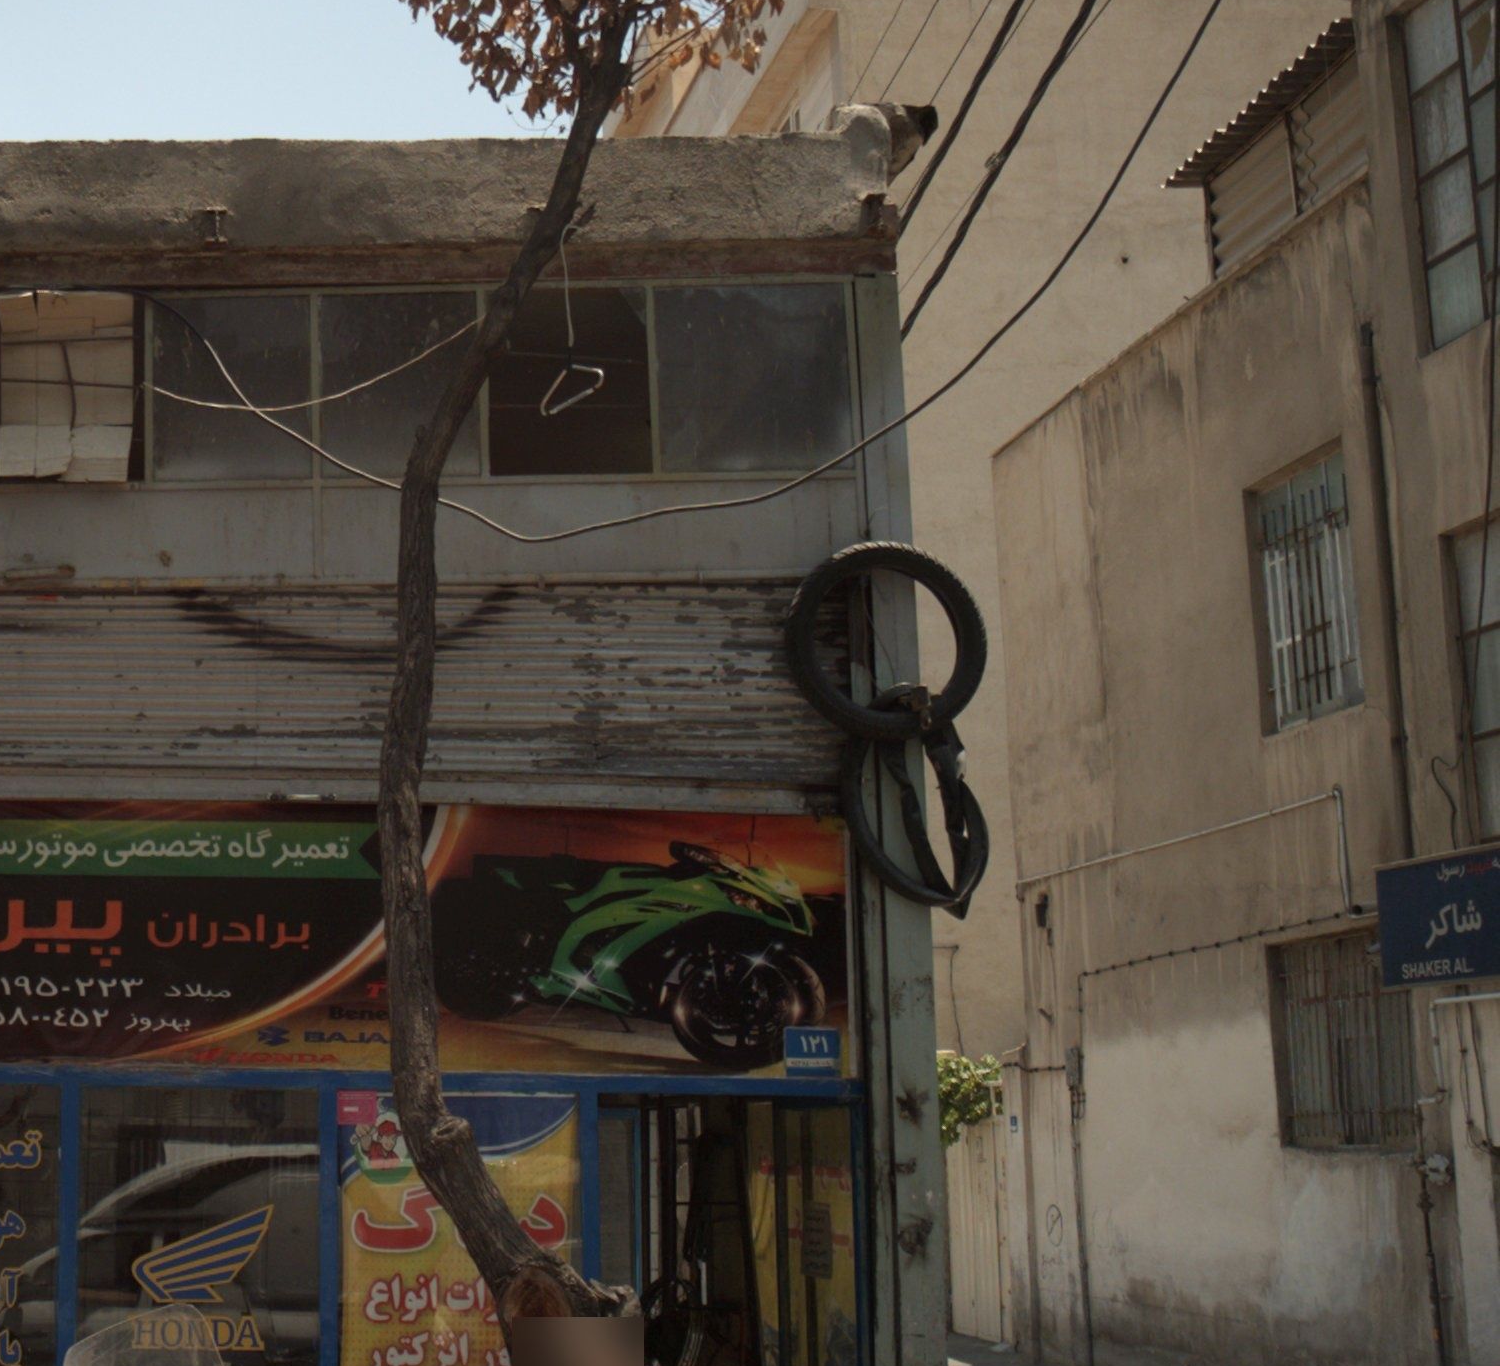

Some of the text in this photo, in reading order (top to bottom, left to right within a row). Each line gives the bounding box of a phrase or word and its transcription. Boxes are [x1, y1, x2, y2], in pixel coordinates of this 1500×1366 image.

[103, 832, 222, 867] تخصصی
[1437, 863, 1466, 882] رسول
[146, 911, 312, 951] برادران
[1424, 899, 1482, 950] شاکر
[1401, 959, 1452, 980] SHAKER
[164, 982, 233, 1002] میلاد
[124, 1011, 193, 1032] بهروز
[329, 1006, 390, 1021] Bene
[303, 1031, 390, 1044] BAJA
[799, 1035, 829, 1054] ۱۲۱
[227, 1050, 339, 1064] HONDA
[363, 1272, 440, 1323] انواع
[132, 1315, 265, 1351] HONDA
